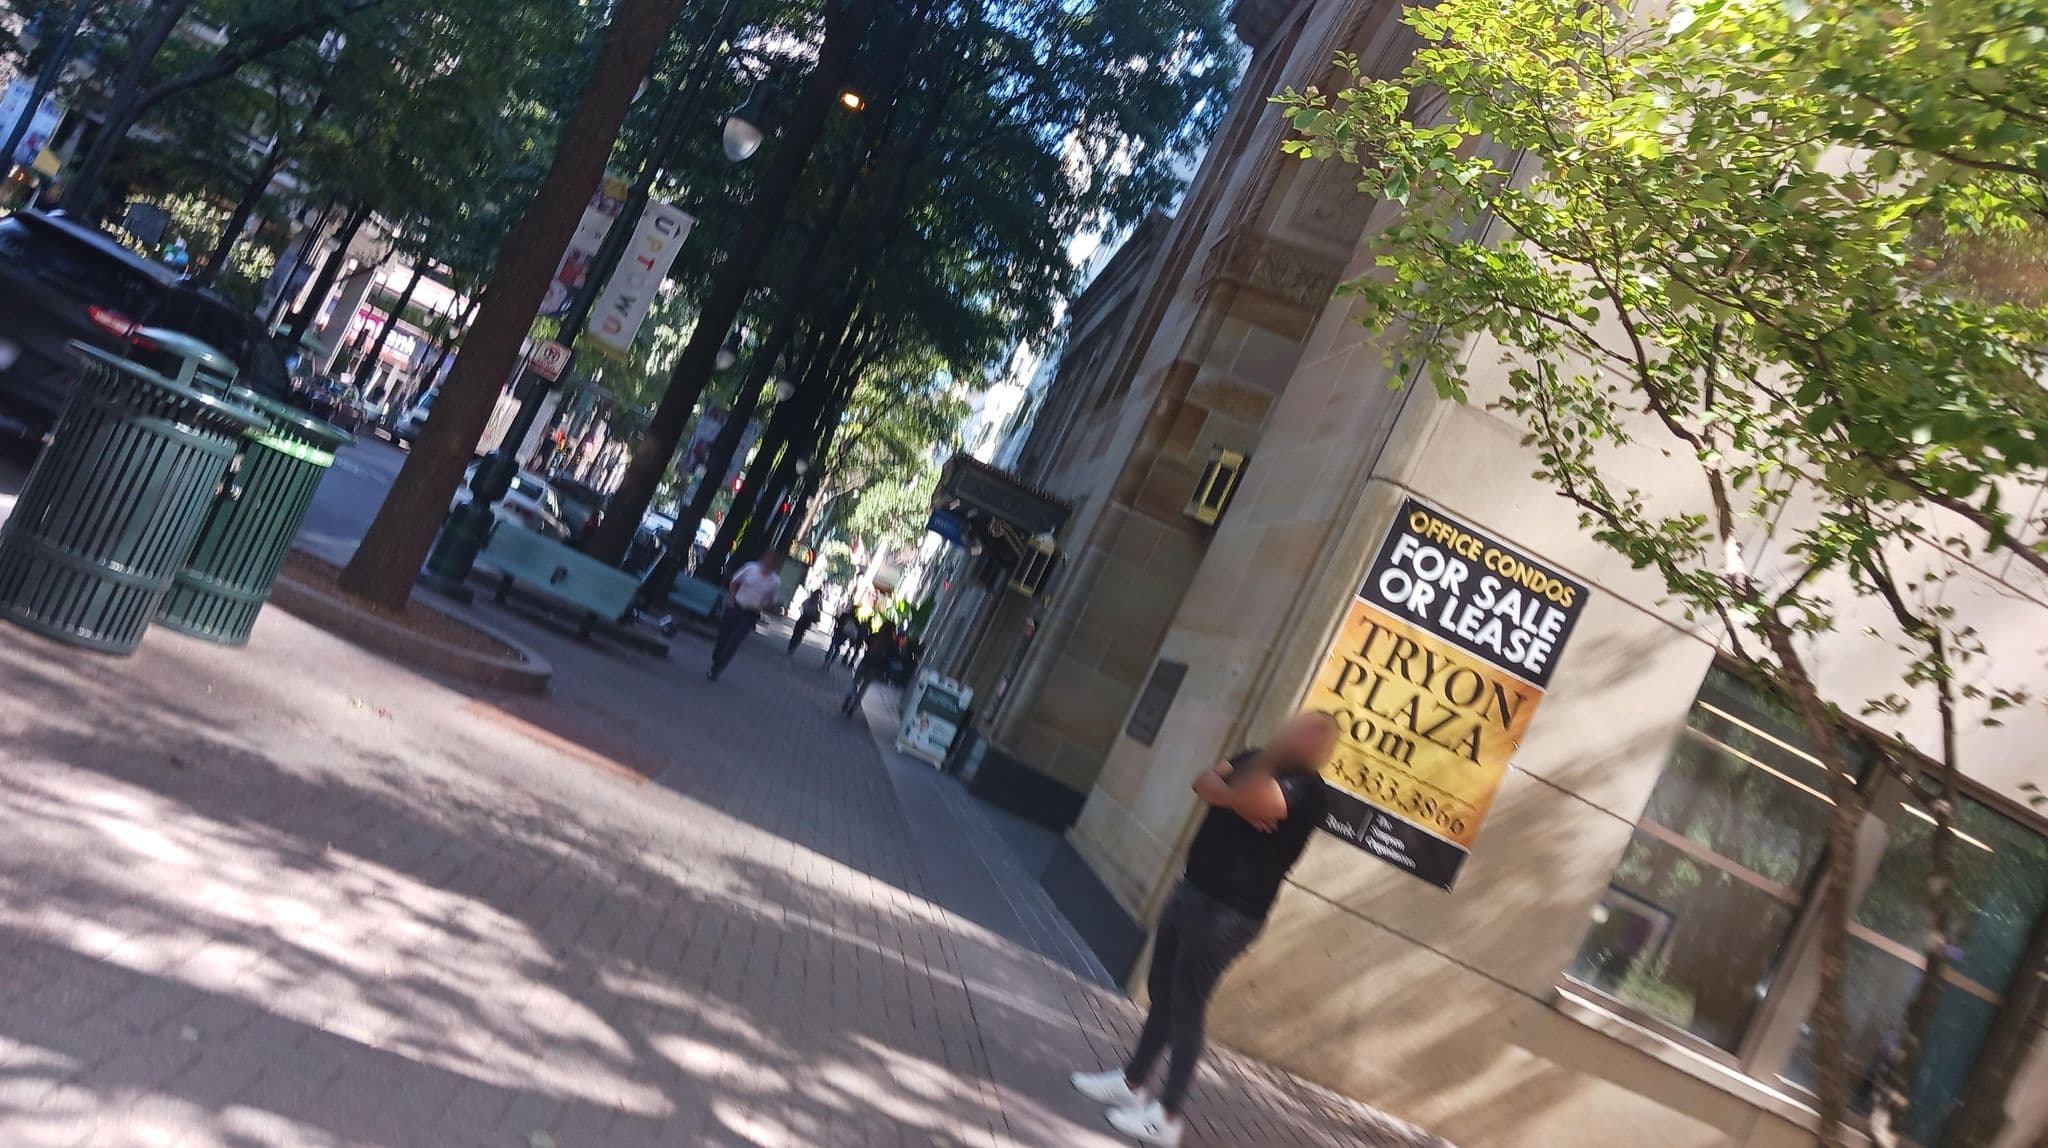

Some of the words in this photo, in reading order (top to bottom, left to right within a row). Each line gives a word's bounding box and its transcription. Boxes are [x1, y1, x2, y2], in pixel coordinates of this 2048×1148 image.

[1390, 532, 1469, 597] FOR
[1472, 575, 1567, 644] SALE
[1409, 510, 1484, 563] OFFICE
[1484, 547, 1577, 609] CONDOS
[1359, 615, 1528, 731] TRYON
[1379, 567, 1436, 620] OR
[1438, 594, 1553, 675] LEASE
[1327, 655, 1481, 767] PLAZA
